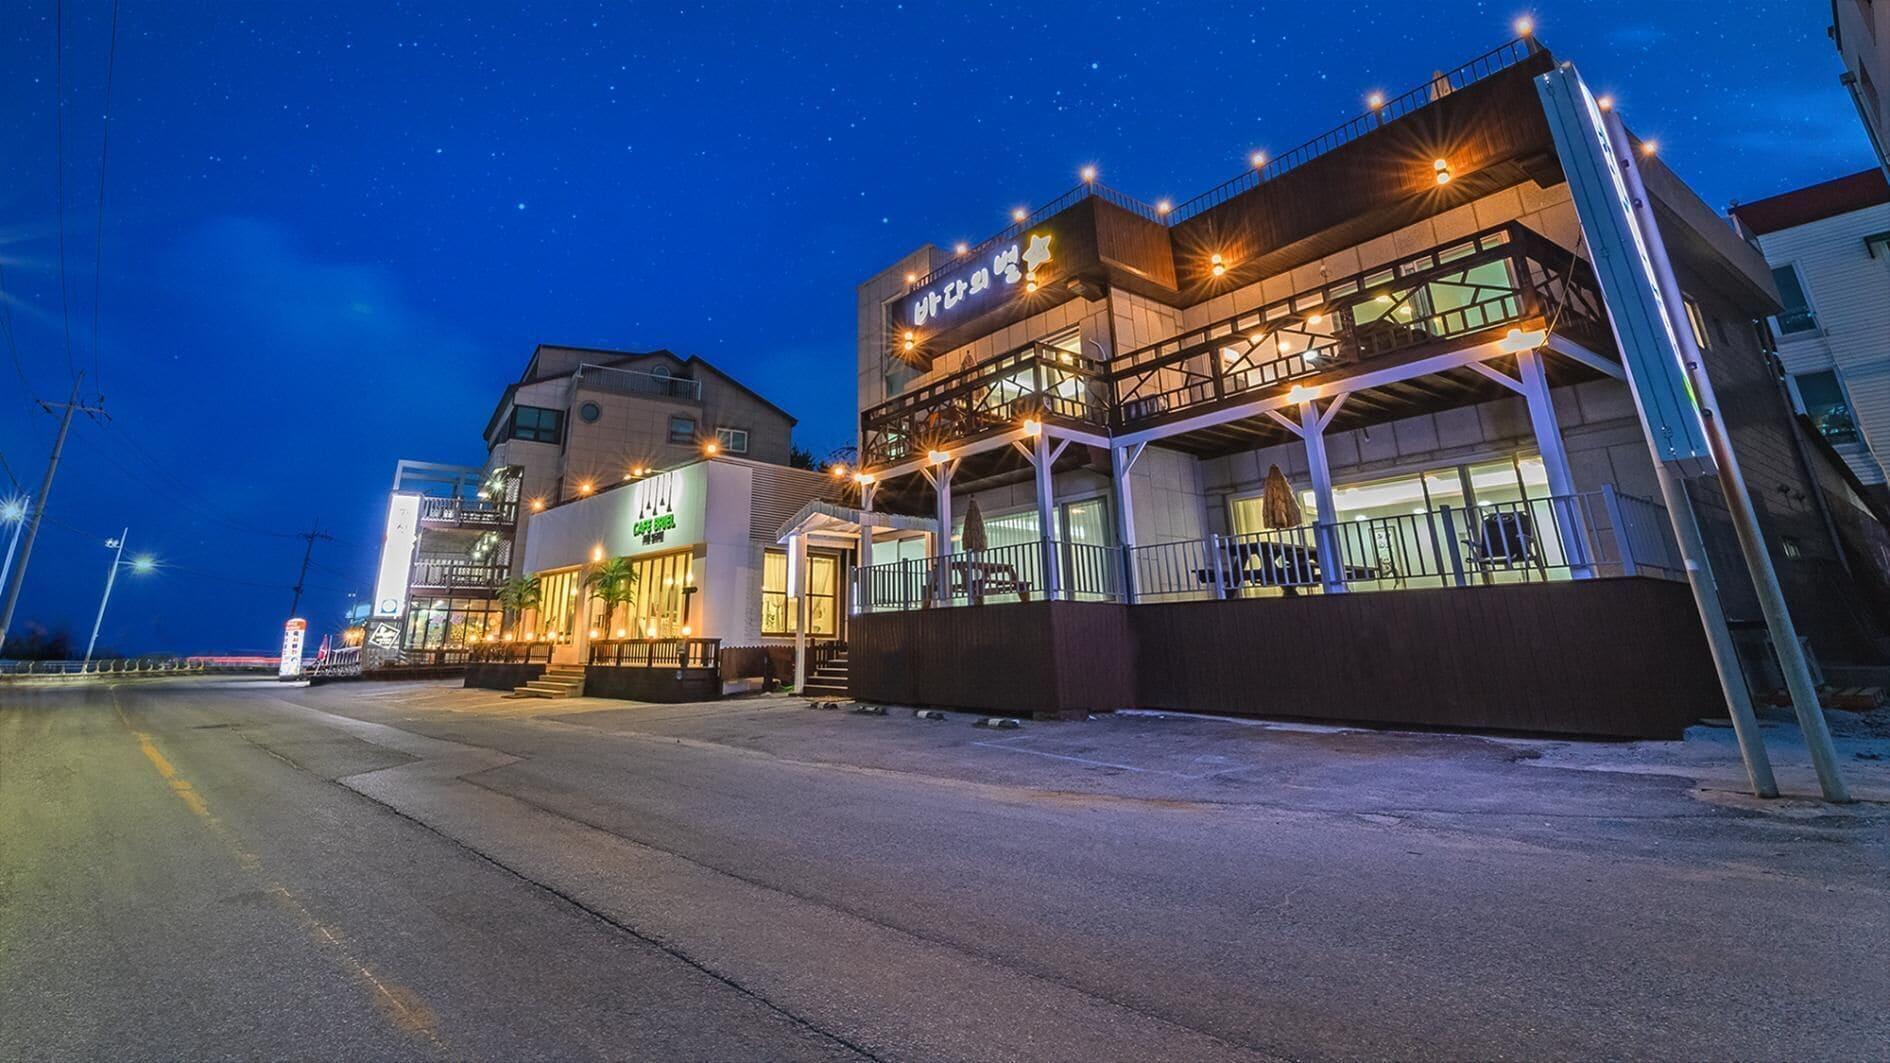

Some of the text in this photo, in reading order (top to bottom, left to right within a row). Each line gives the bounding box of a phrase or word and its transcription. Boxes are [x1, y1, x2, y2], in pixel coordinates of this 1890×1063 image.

[914, 244, 1022, 325] 바다의 별
[633, 519, 652, 536] CAFE
